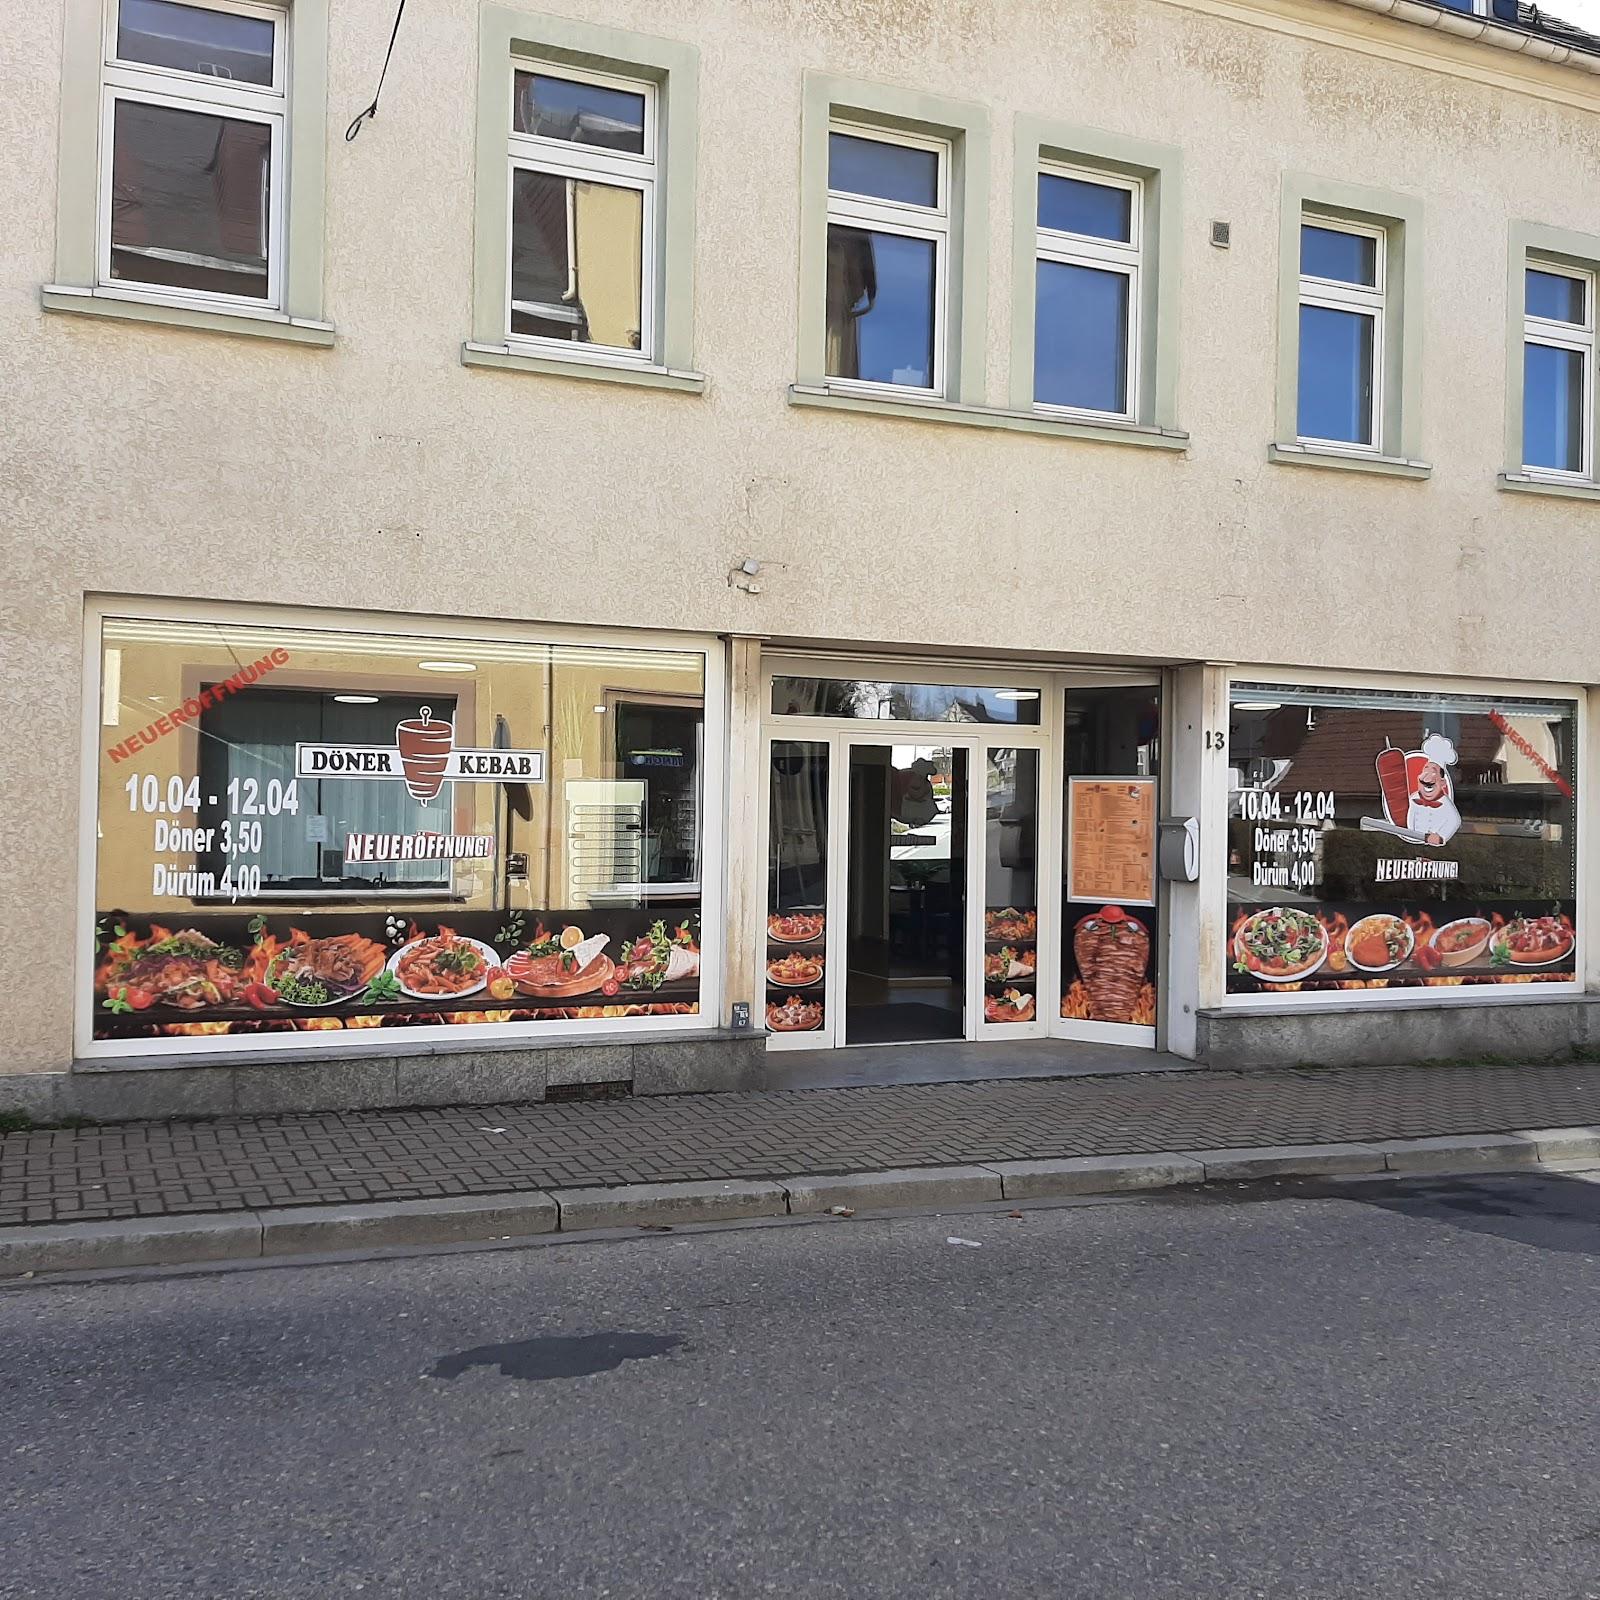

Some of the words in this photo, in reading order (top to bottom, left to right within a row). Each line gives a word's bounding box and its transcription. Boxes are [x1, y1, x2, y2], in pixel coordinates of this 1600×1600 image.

[107, 648, 289, 763] NEUERÖFFNUNG
[1206, 730, 1225, 750] 13
[1488, 708, 1573, 799] NUERÖFFNU
[311, 750, 392, 773] DÖNER
[459, 755, 532, 775] KEBAB
[125, 773, 201, 814] 10.04
[227, 777, 299, 816] 12.04
[1239, 791, 1281, 820] 10.04
[1294, 791, 1335, 820] 12.04
[154, 819, 215, 852] Döner
[220, 820, 262, 860] 3,50
[347, 832, 488, 861] NEUERÖFFNUNG!
[1255, 827, 1289, 852] Döner
[1291, 827, 1316, 858] 3,50
[1253, 861, 1289, 886] Dürüm
[1291, 861, 1315, 891] 4,00
[1376, 857, 1458, 880] NEUERÖFFNUNG!
[153, 863, 215, 896] Dürüm
[220, 864, 261, 905] 4,00
